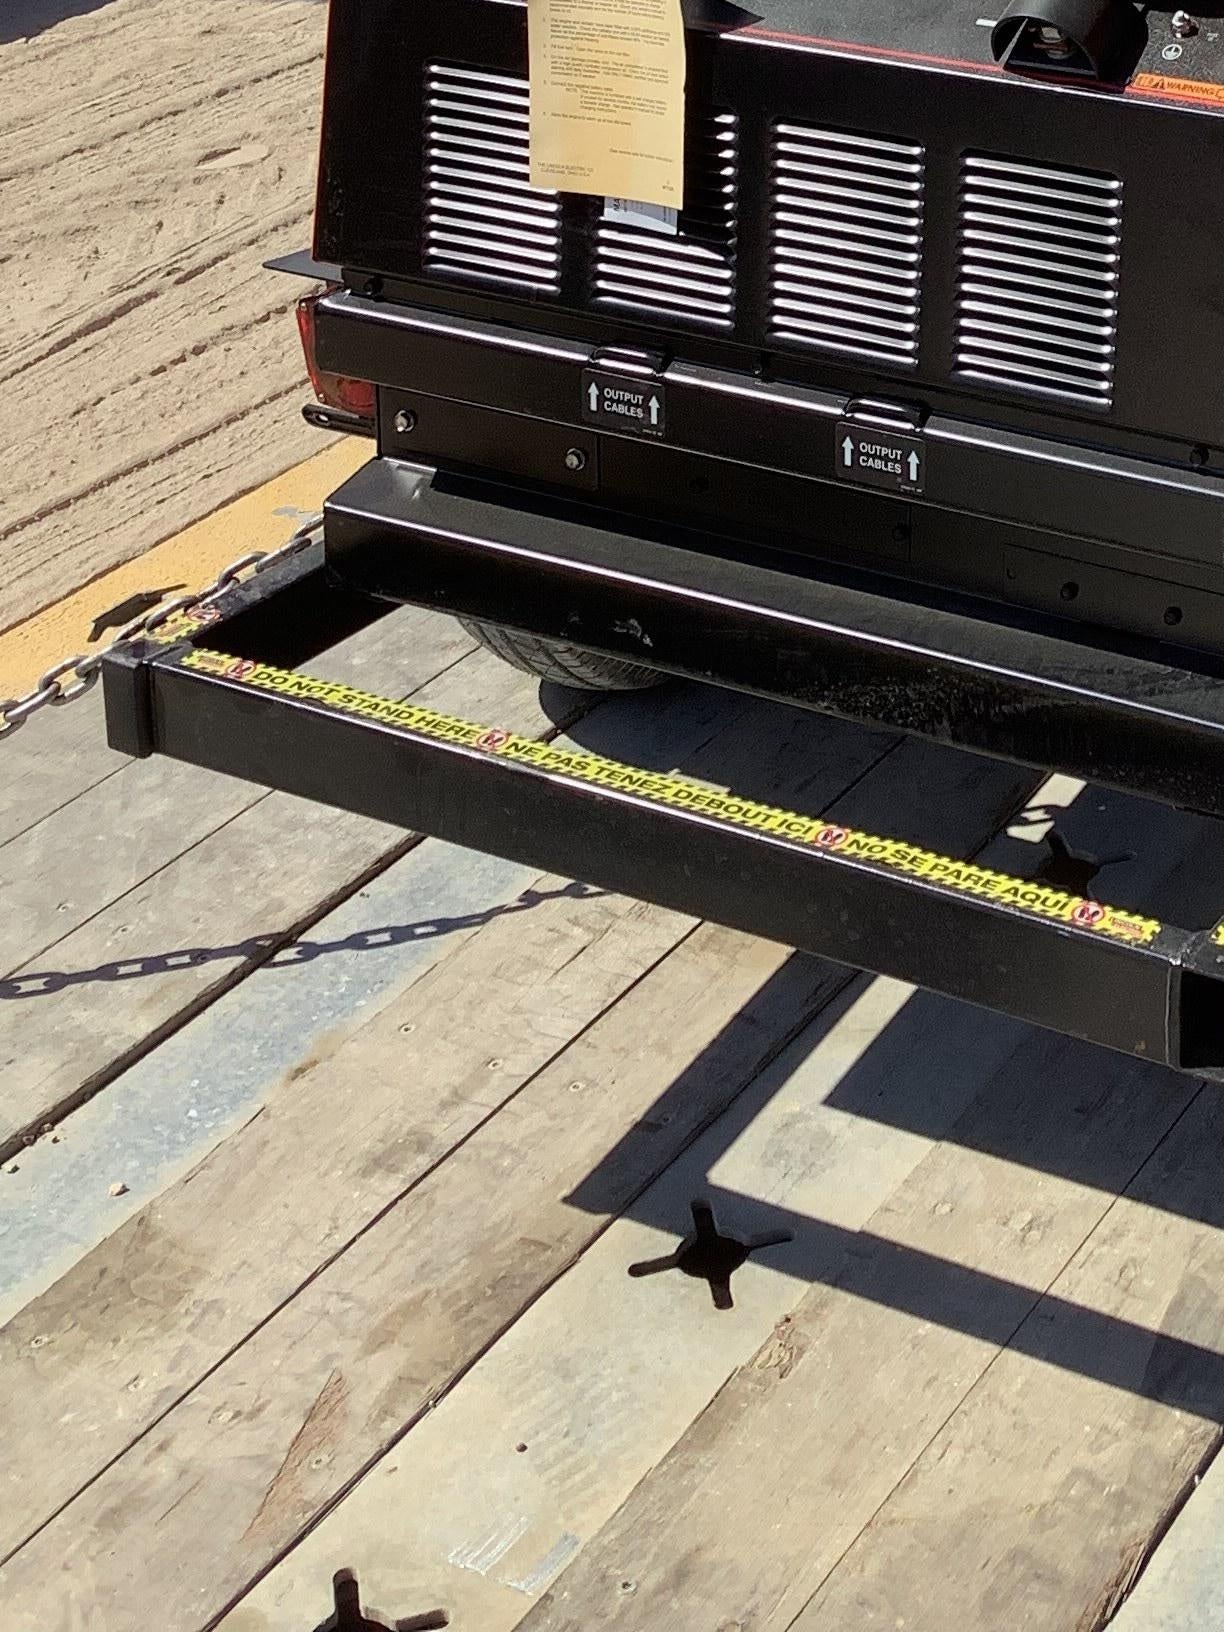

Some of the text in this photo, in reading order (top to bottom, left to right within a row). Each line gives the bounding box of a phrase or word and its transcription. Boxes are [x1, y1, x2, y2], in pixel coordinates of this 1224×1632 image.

[1166, 81, 1216, 97] WARNING
[603, 387, 644, 406] OUTPUT
[603, 400, 644, 419] CABLES
[858, 441, 903, 462] OUTPUT
[858, 455, 902, 475] CABLES
[253, 670, 286, 686] DO
[290, 680, 337, 697] NOT
[339, 693, 415, 720] STAND
[414, 716, 484, 740] HERE
[505, 740, 539, 755] NE
[541, 752, 590, 772] PAS
[593, 766, 675, 795] TENEZ
[671, 788, 779, 824] DEBOUT
[776, 818, 816, 837] ICI
[848, 838, 887, 854] NO
[890, 848, 930, 868] SE
[928, 862, 1003, 890] PARE
